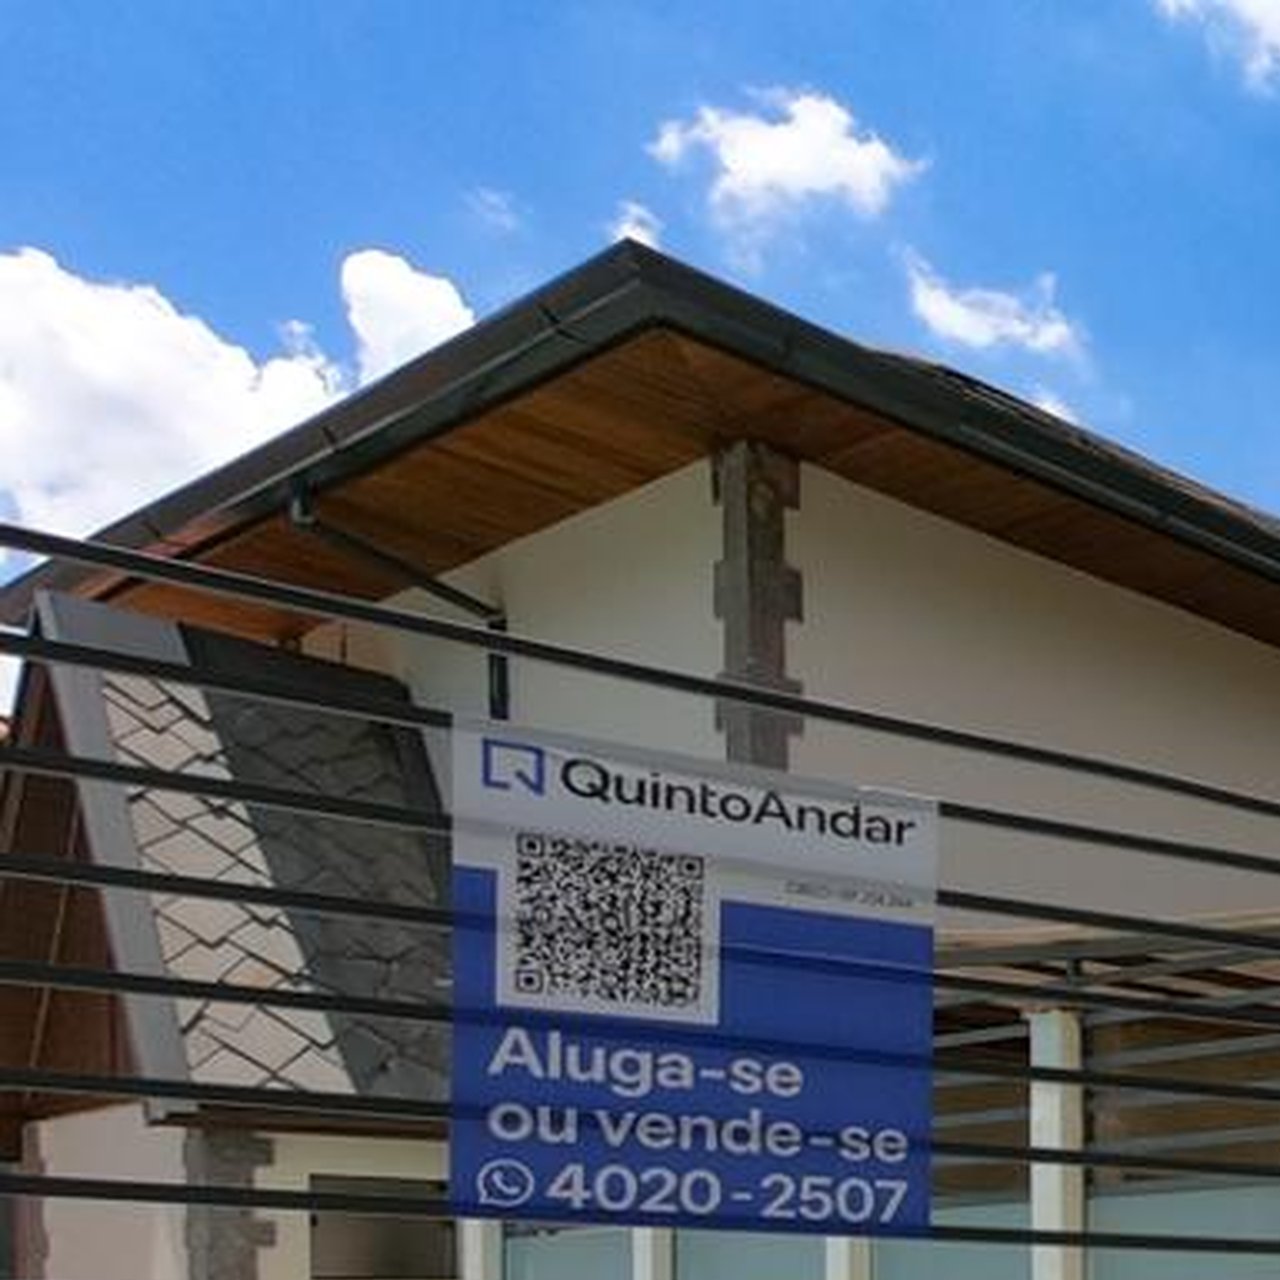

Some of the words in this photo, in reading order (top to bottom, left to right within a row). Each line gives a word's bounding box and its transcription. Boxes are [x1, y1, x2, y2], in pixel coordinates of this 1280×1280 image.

[560, 758, 915, 846] QuintoAndar
[489, 1027, 802, 1097] Aluga-se
[488, 1103, 578, 1143] ou
[601, 1108, 908, 1162] vende-se
[546, 1164, 908, 1224] 4020-2507
